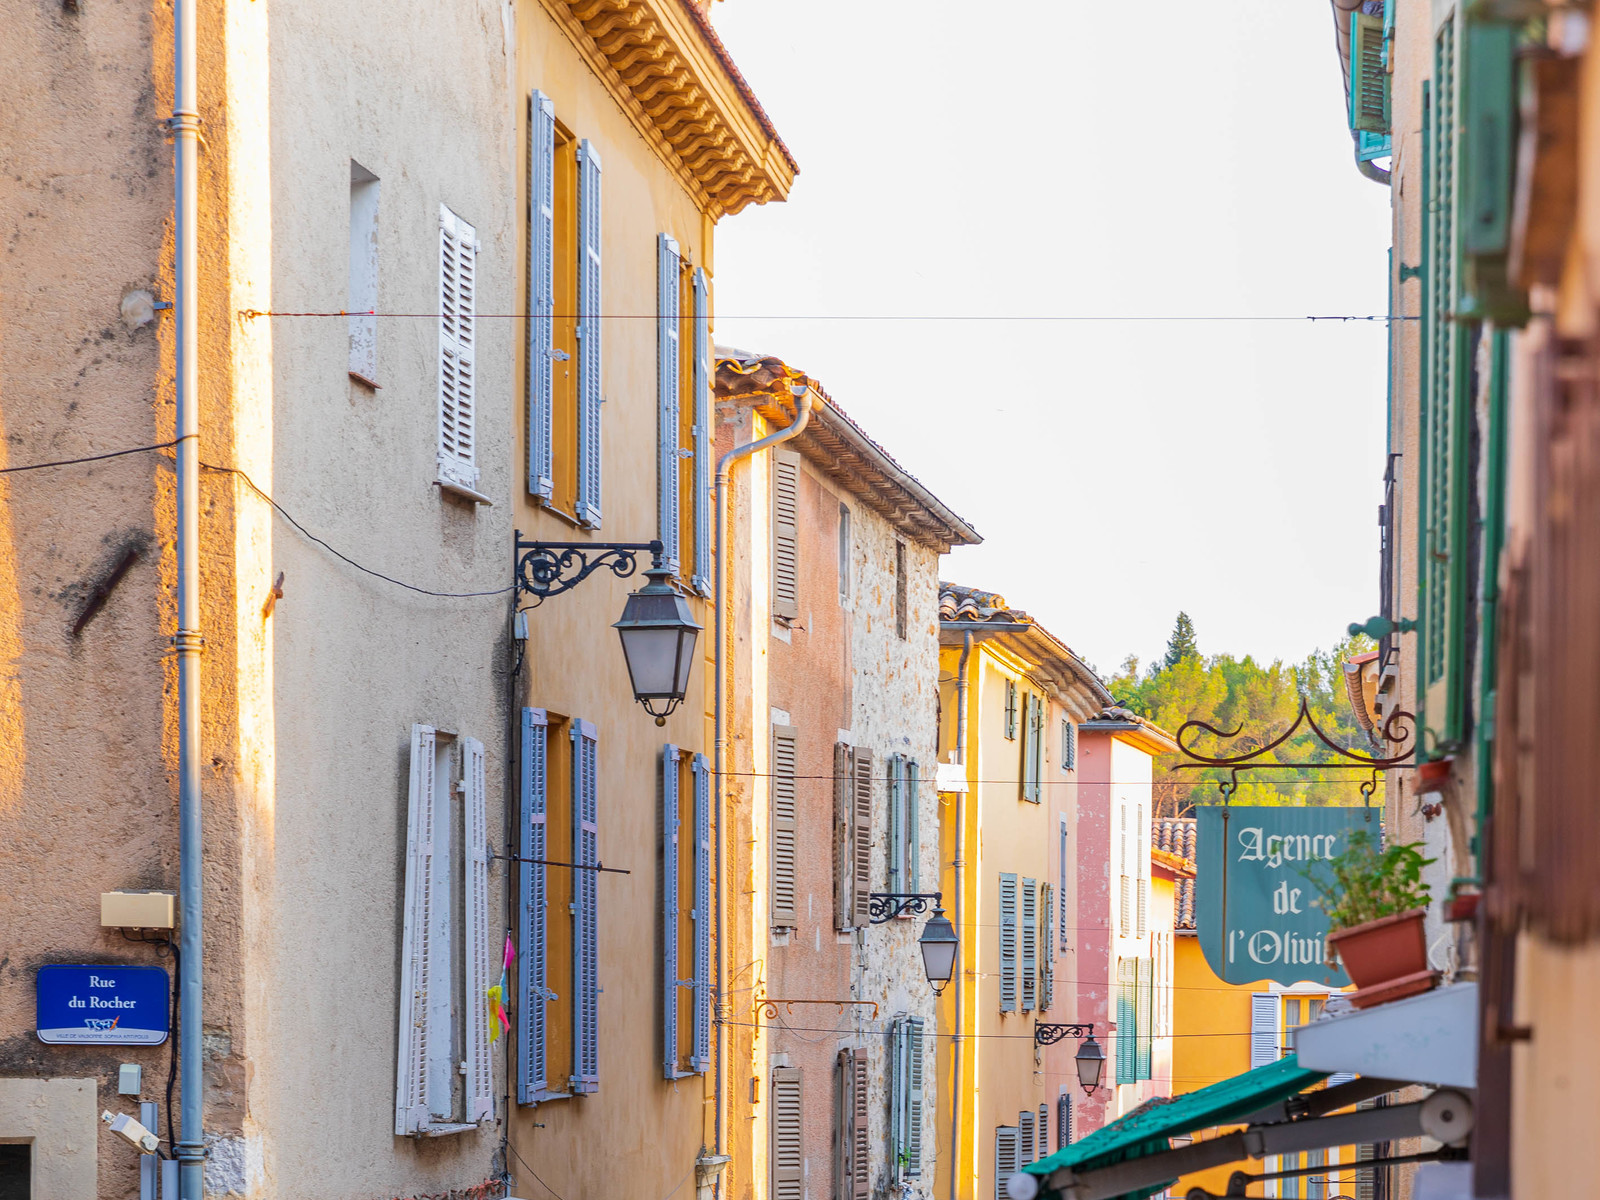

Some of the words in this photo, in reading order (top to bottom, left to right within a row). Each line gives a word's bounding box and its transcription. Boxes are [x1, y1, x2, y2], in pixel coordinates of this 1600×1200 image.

[1237, 827, 1336, 869] Agence
[1273, 880, 1303, 915] de
[1228, 930, 1344, 965] l'Olivi
[89, 975, 116, 988] Rue
[68, 996, 86, 1009] du
[89, 995, 137, 1009] Rocher
